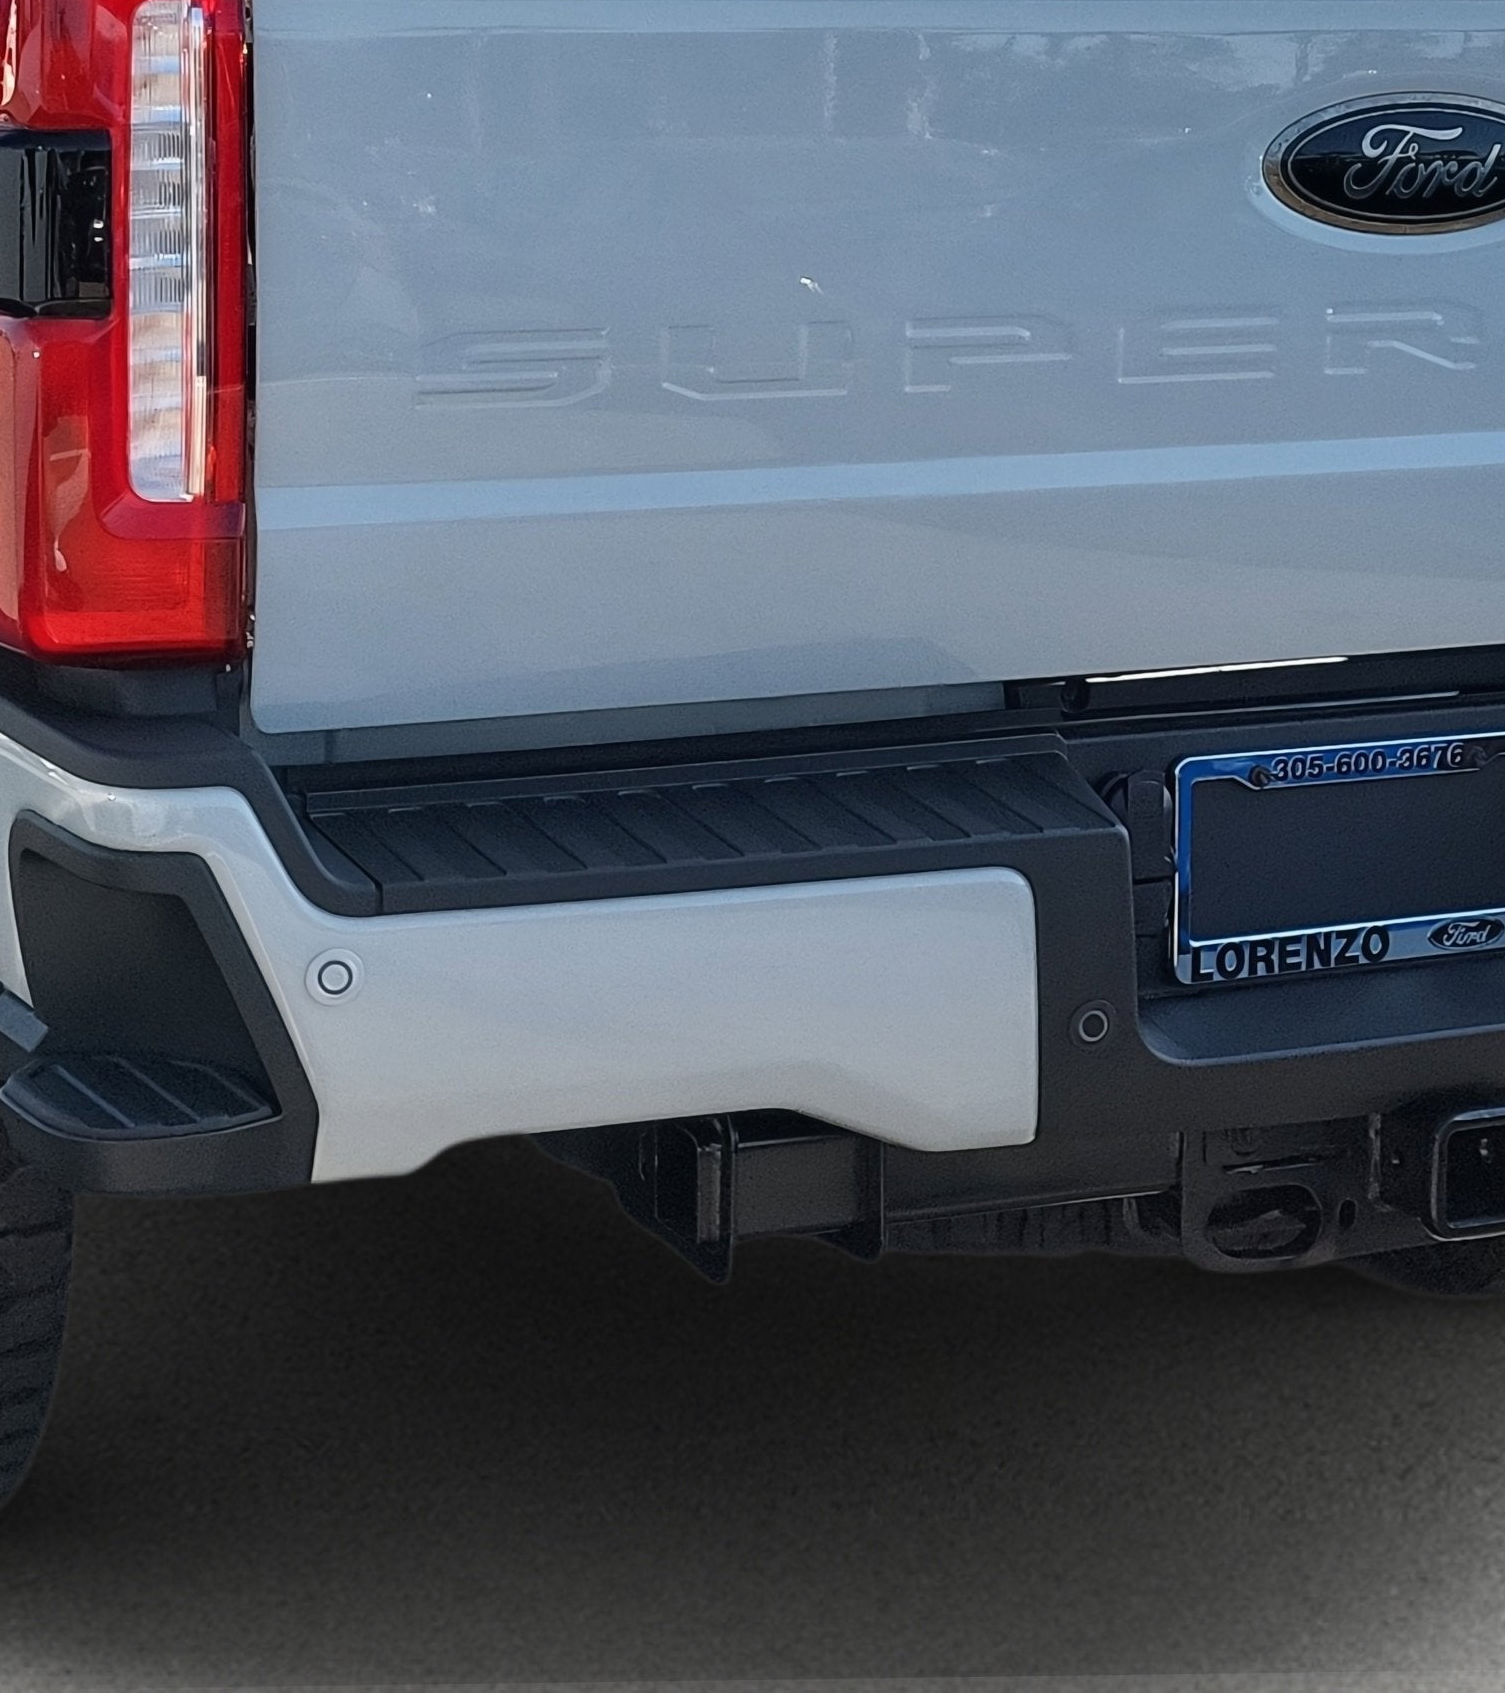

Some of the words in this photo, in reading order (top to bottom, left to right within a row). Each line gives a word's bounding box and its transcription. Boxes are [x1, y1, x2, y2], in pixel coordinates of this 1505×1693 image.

[1344, 124, 1502, 199] Ford
[413, 300, 1484, 410] SUPER
[1268, 742, 1466, 783] 305-600-3676
[1191, 925, 1391, 983] LORENZO
[1442, 921, 1492, 948] Ford
